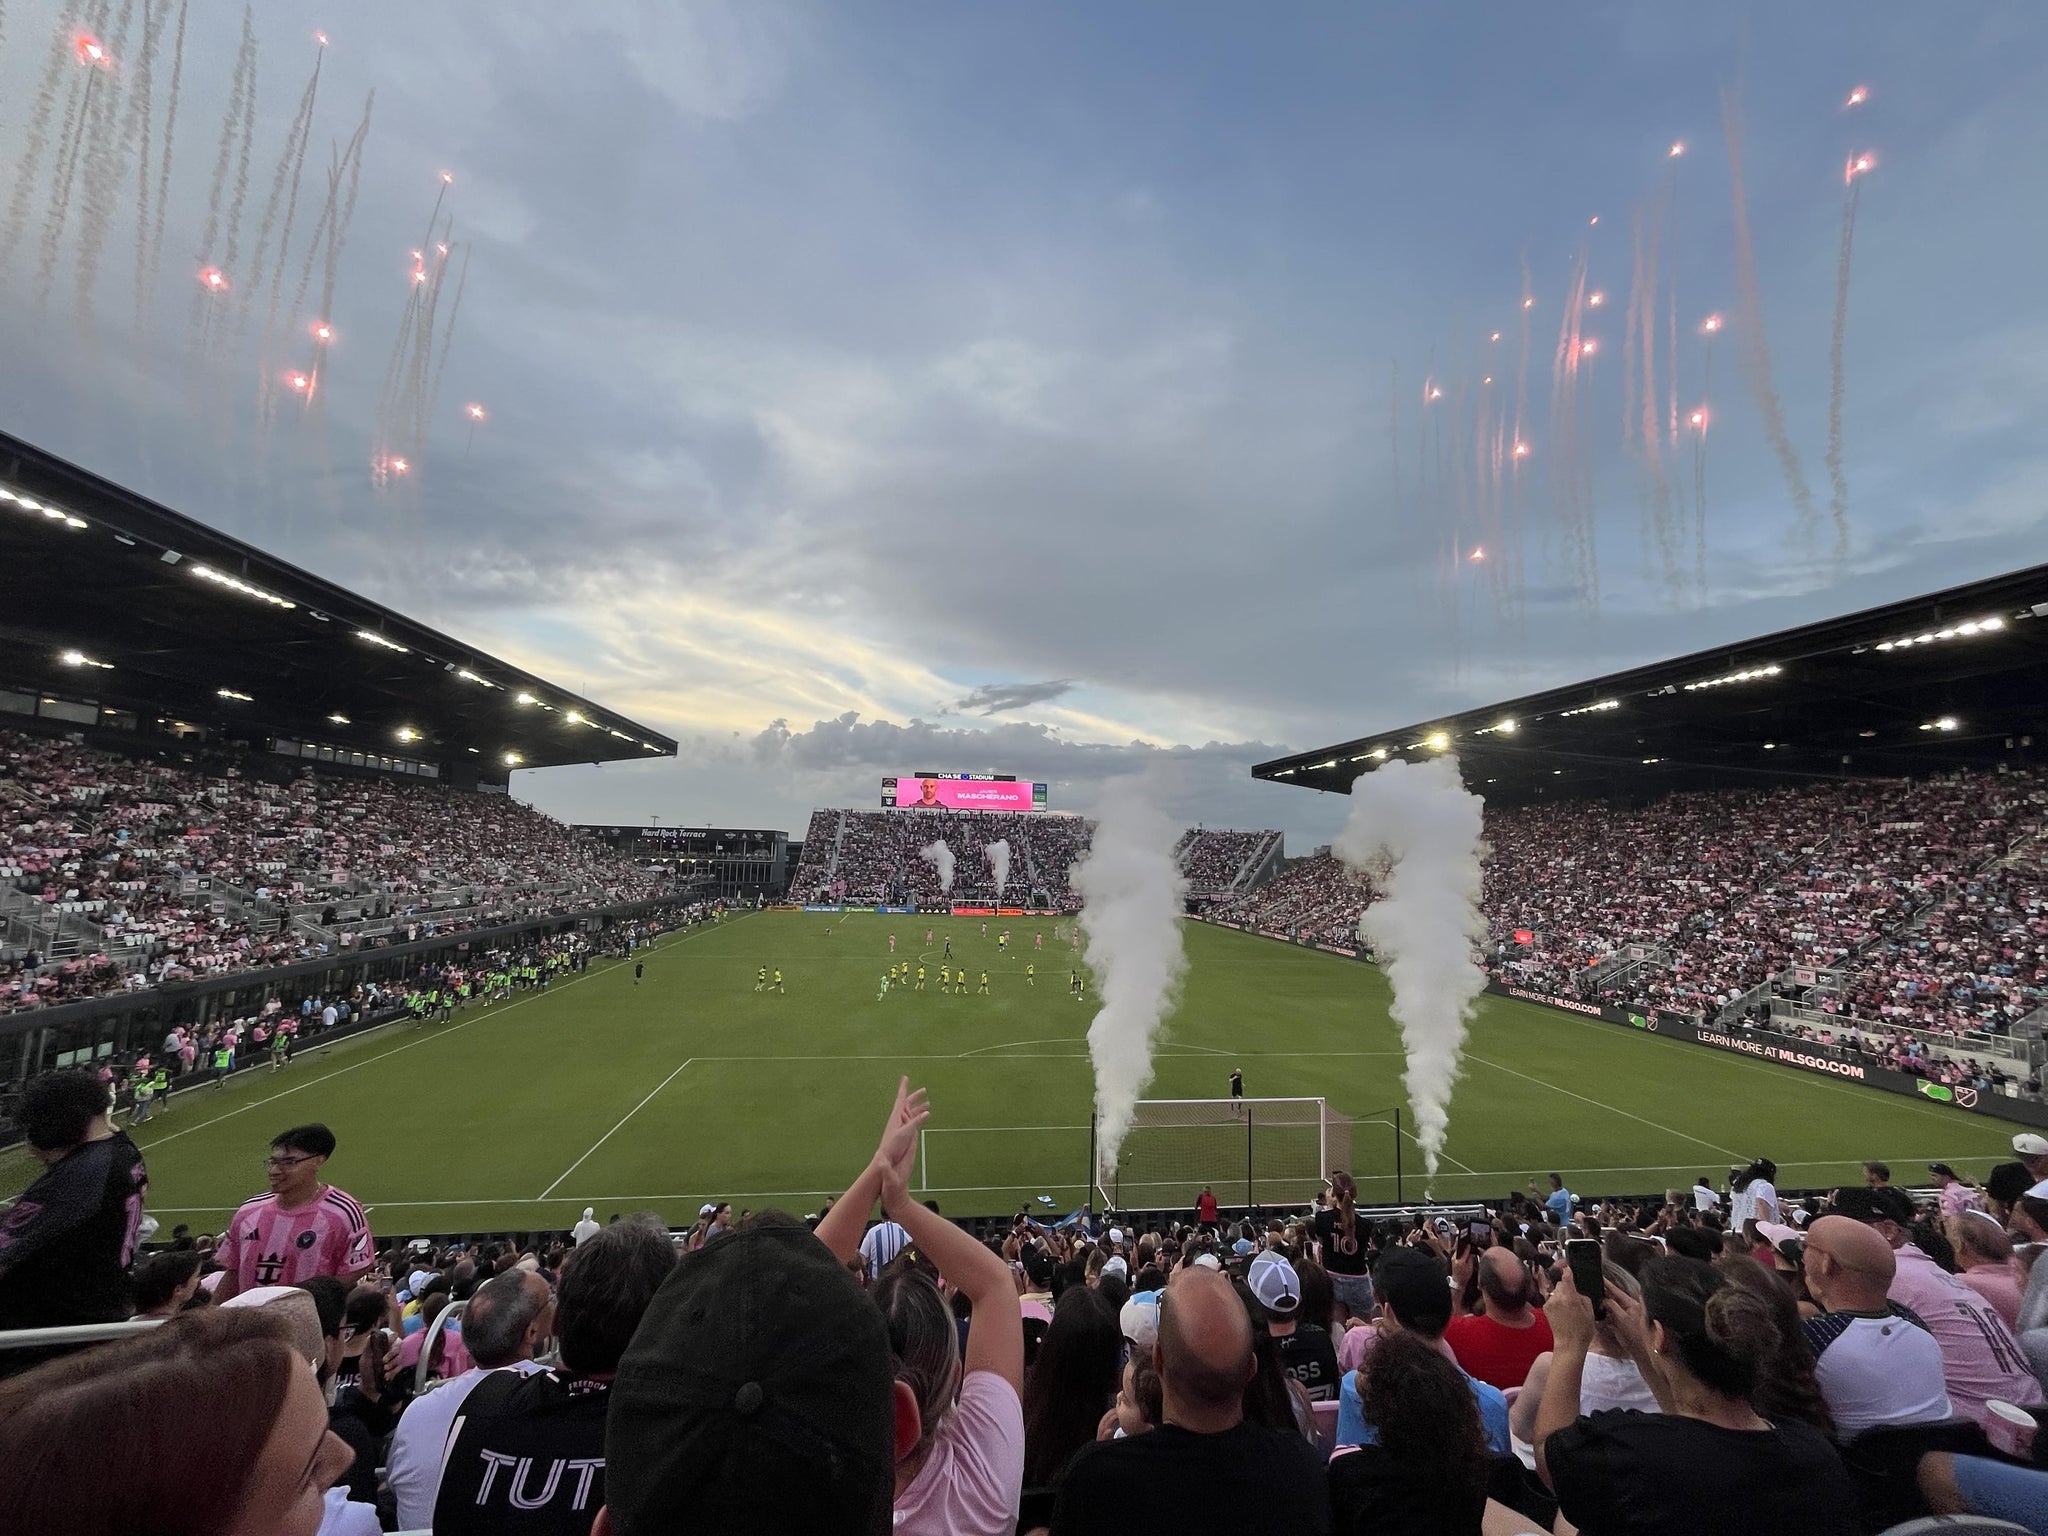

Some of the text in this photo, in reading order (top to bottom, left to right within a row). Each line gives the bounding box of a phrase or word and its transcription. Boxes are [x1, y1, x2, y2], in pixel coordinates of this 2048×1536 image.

[957, 793, 1018, 801] MASCHERANO
[641, 828, 707, 839] Hard Rock Terrace
[1509, 987, 1601, 1016] LEARN MORE AT MLSGO.COM
[1697, 1030, 1865, 1080] LEARN MORE AT MLSGO.COM
[1330, 1232, 1358, 1255] 10
[568, 1380, 608, 1391] FREEDOM
[475, 1448, 606, 1510] TUT
